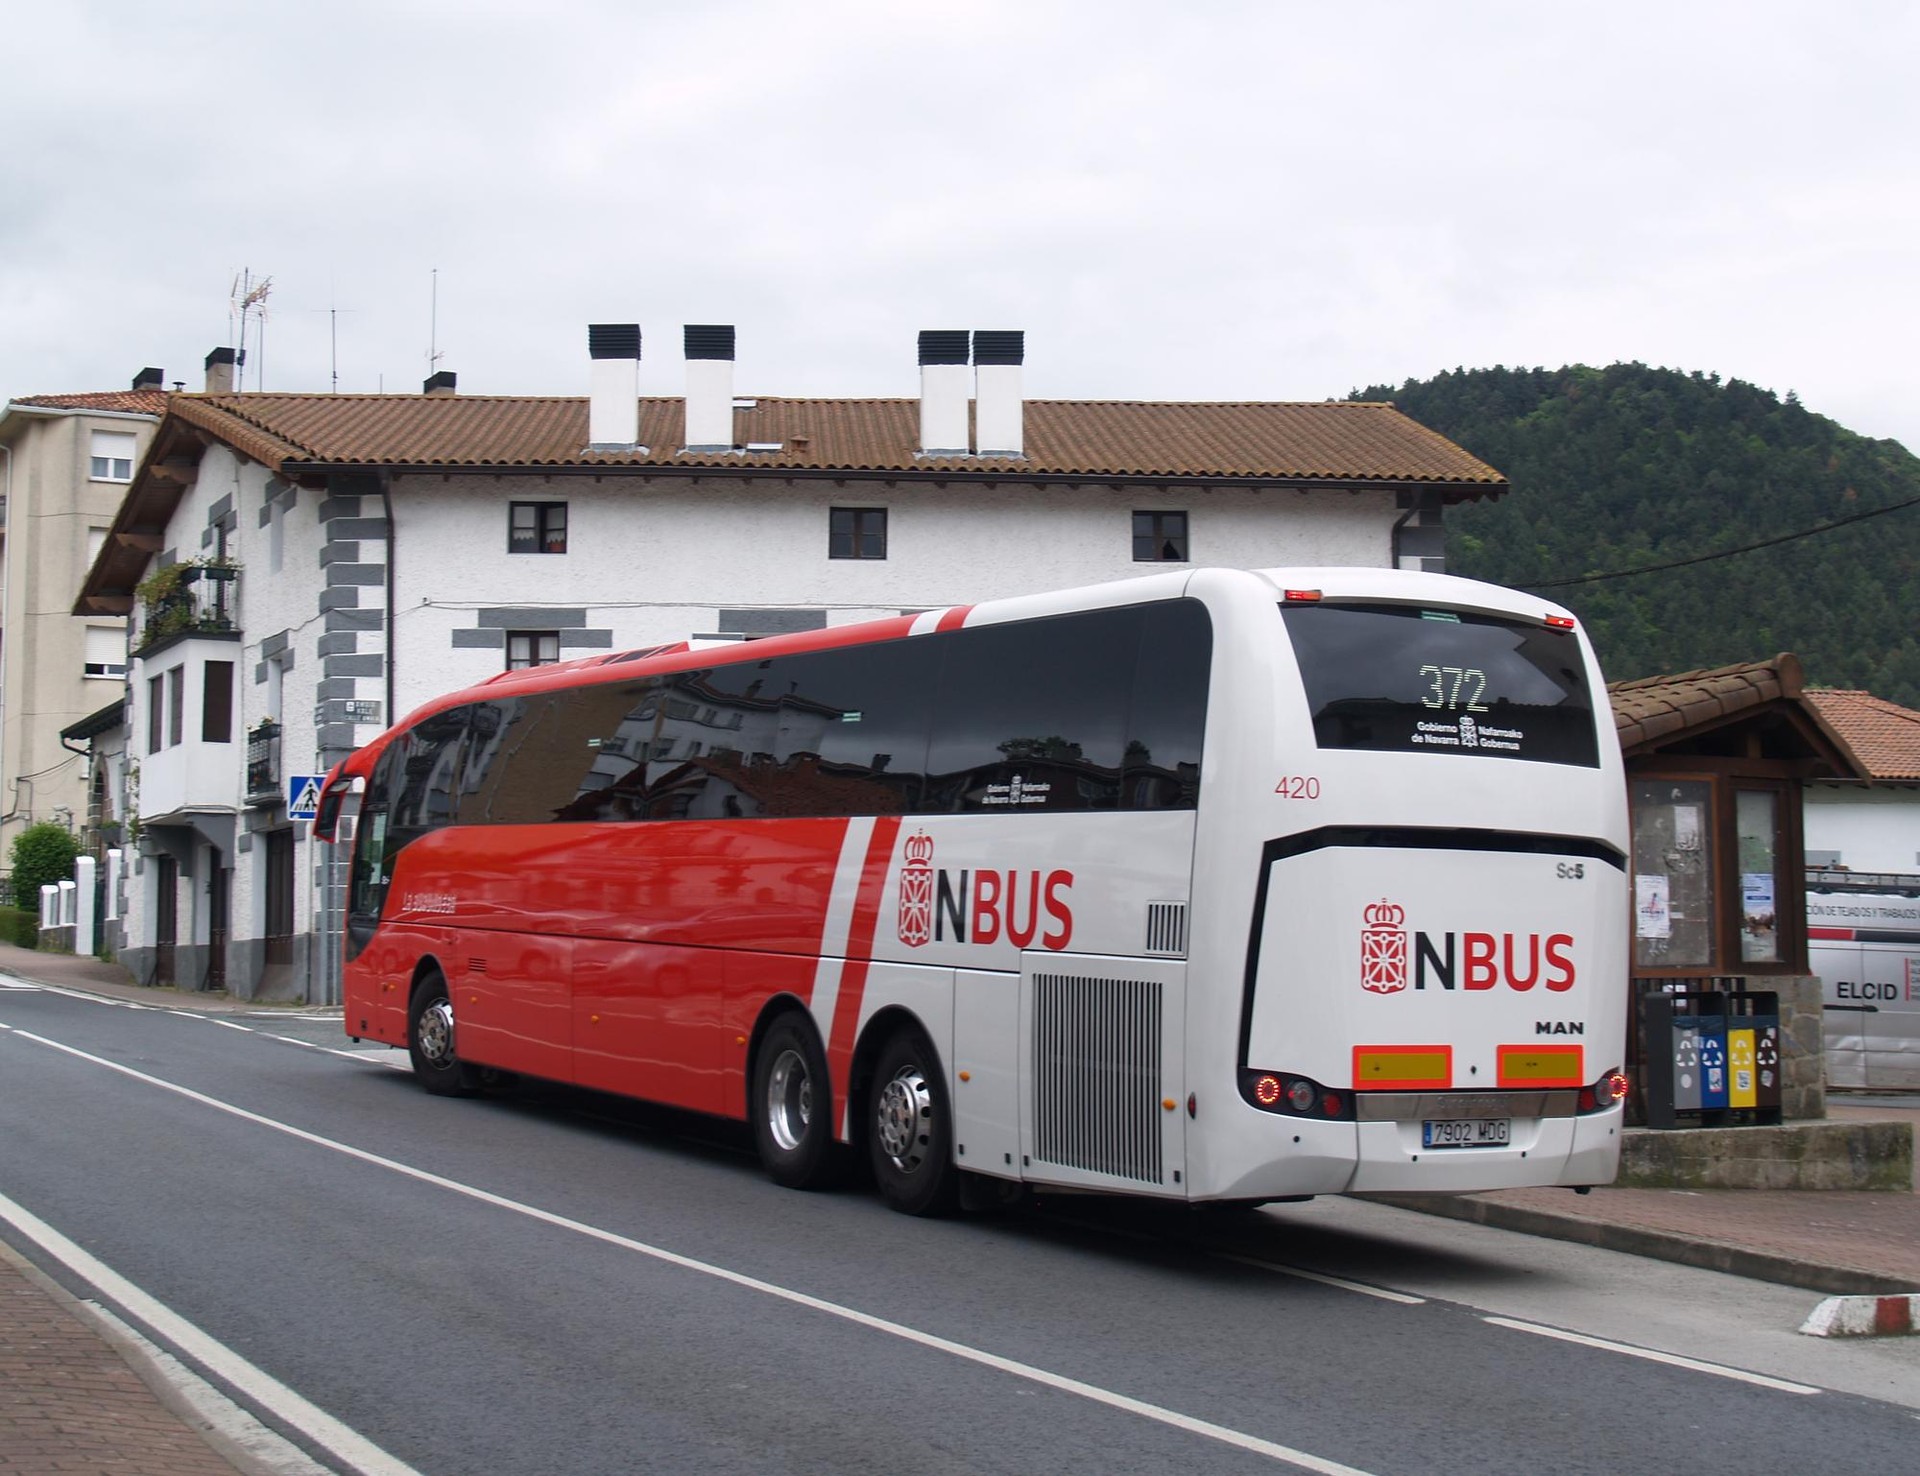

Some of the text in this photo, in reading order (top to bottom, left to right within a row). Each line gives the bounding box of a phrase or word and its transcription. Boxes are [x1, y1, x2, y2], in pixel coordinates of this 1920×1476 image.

[1419, 665, 1489, 712] 372
[1417, 721, 1524, 739] Gobierno Nafarroako
[1411, 733, 1521, 750] de Navarra Gobernua
[1275, 776, 1320, 799] 420
[1556, 863, 1584, 880] Sc5
[934, 868, 1074, 951] NBUS
[1826, 906, 1836, 916] DE
[1837, 906, 1871, 917] TEJADOS
[1878, 907, 1916, 919] TRABAJOS
[1414, 931, 1576, 993] NBUS
[1837, 982, 1898, 1000] ELCID
[1535, 1021, 1584, 1035] MAN
[1435, 1123, 1472, 1142] 7902
